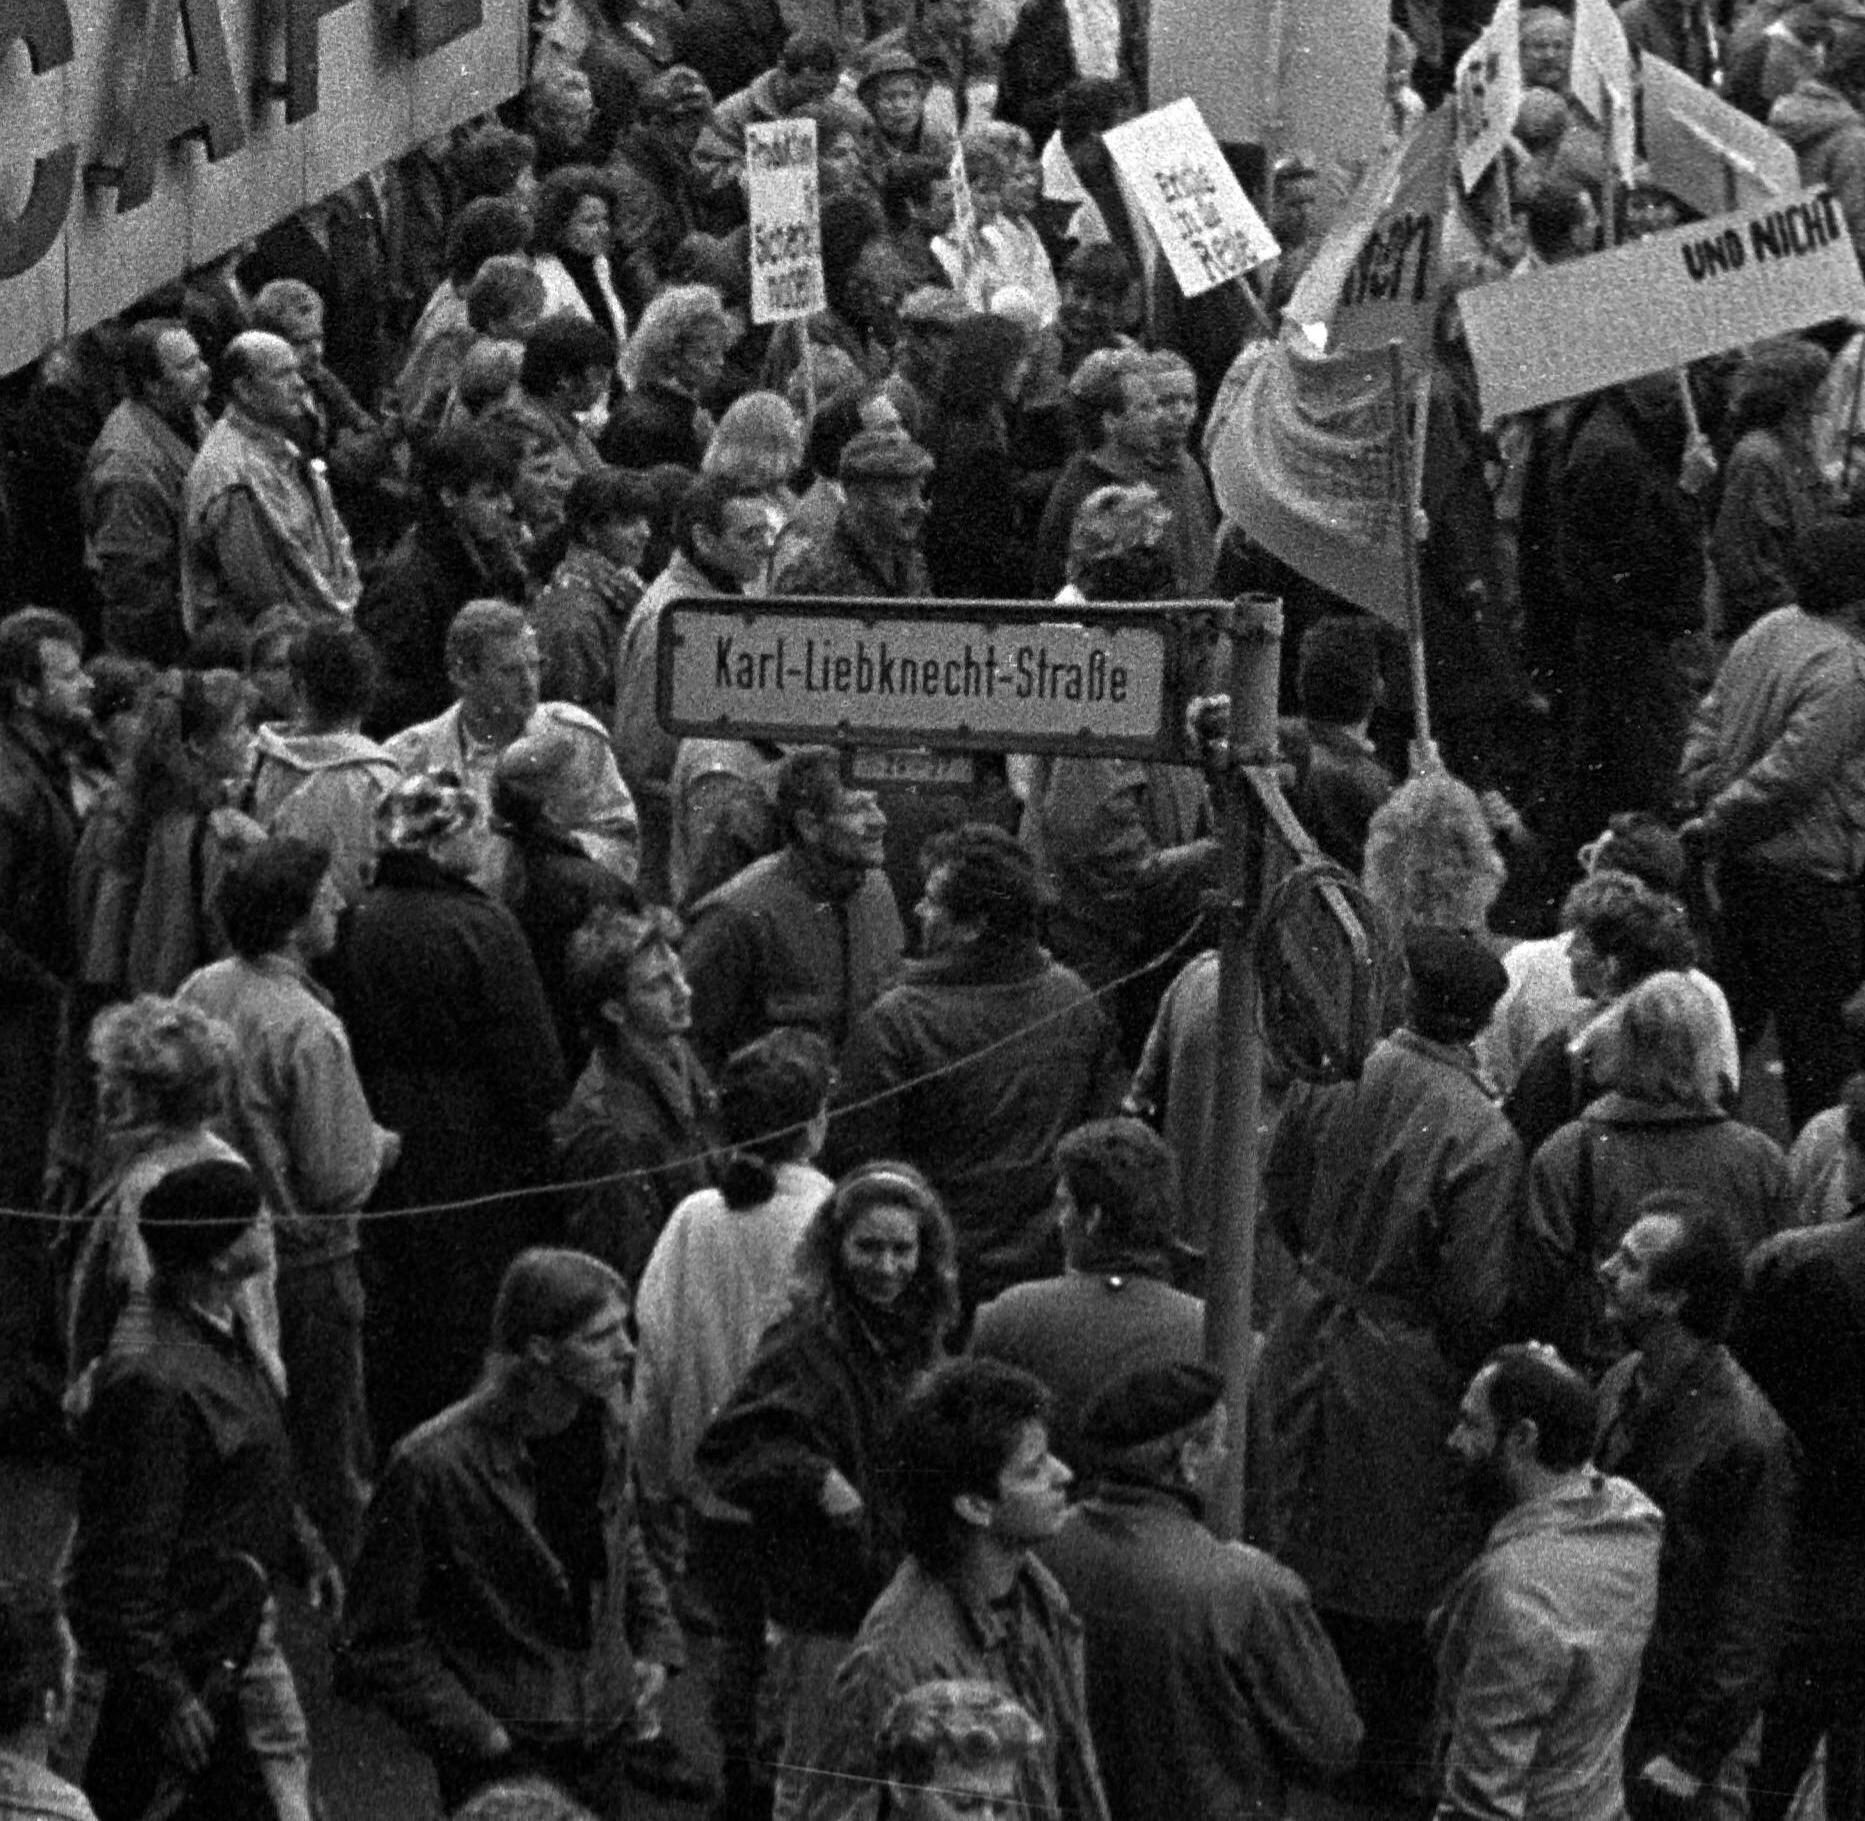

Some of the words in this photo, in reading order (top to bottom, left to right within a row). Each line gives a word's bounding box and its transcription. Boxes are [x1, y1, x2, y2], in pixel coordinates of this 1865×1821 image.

[1681, 229, 1745, 281] UND
[1749, 189, 1839, 266] NICHT
[715, 634, 1129, 704] Karl-Liebknecht-Straße
